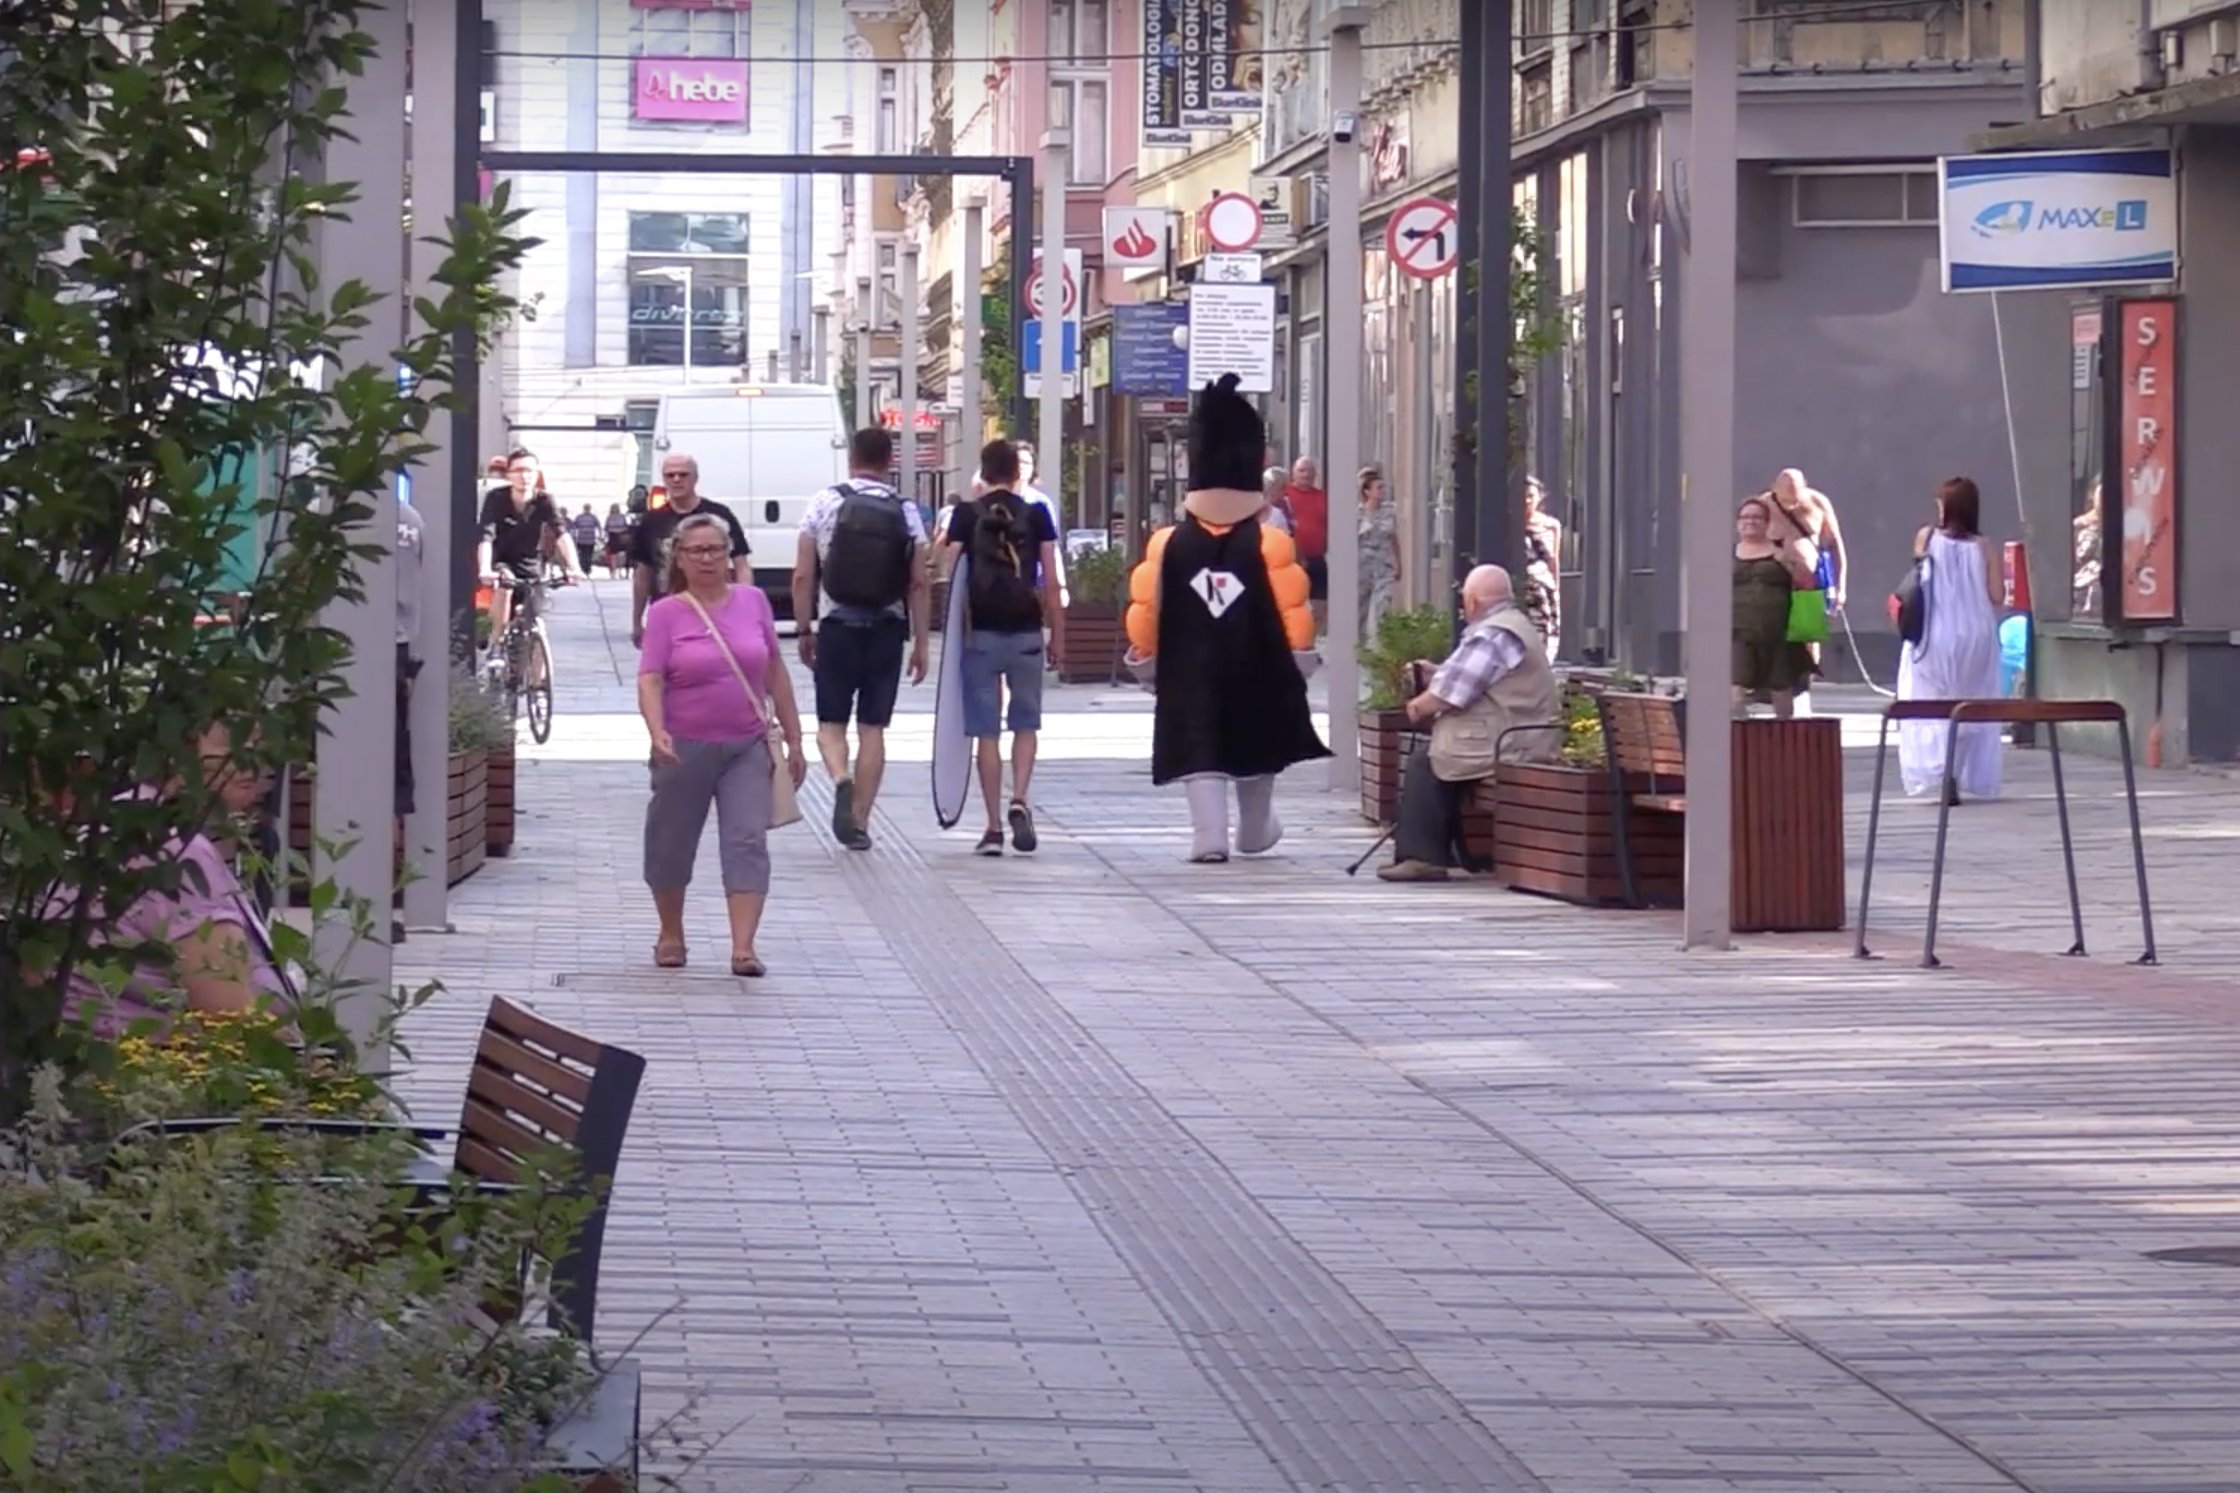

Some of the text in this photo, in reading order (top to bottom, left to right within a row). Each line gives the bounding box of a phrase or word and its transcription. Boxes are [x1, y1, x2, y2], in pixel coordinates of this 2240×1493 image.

[669, 70, 741, 102] hebe
[1146, 0, 1160, 125] STOMATOLOGI
[1211, 0, 1227, 90] ODMŁAD
